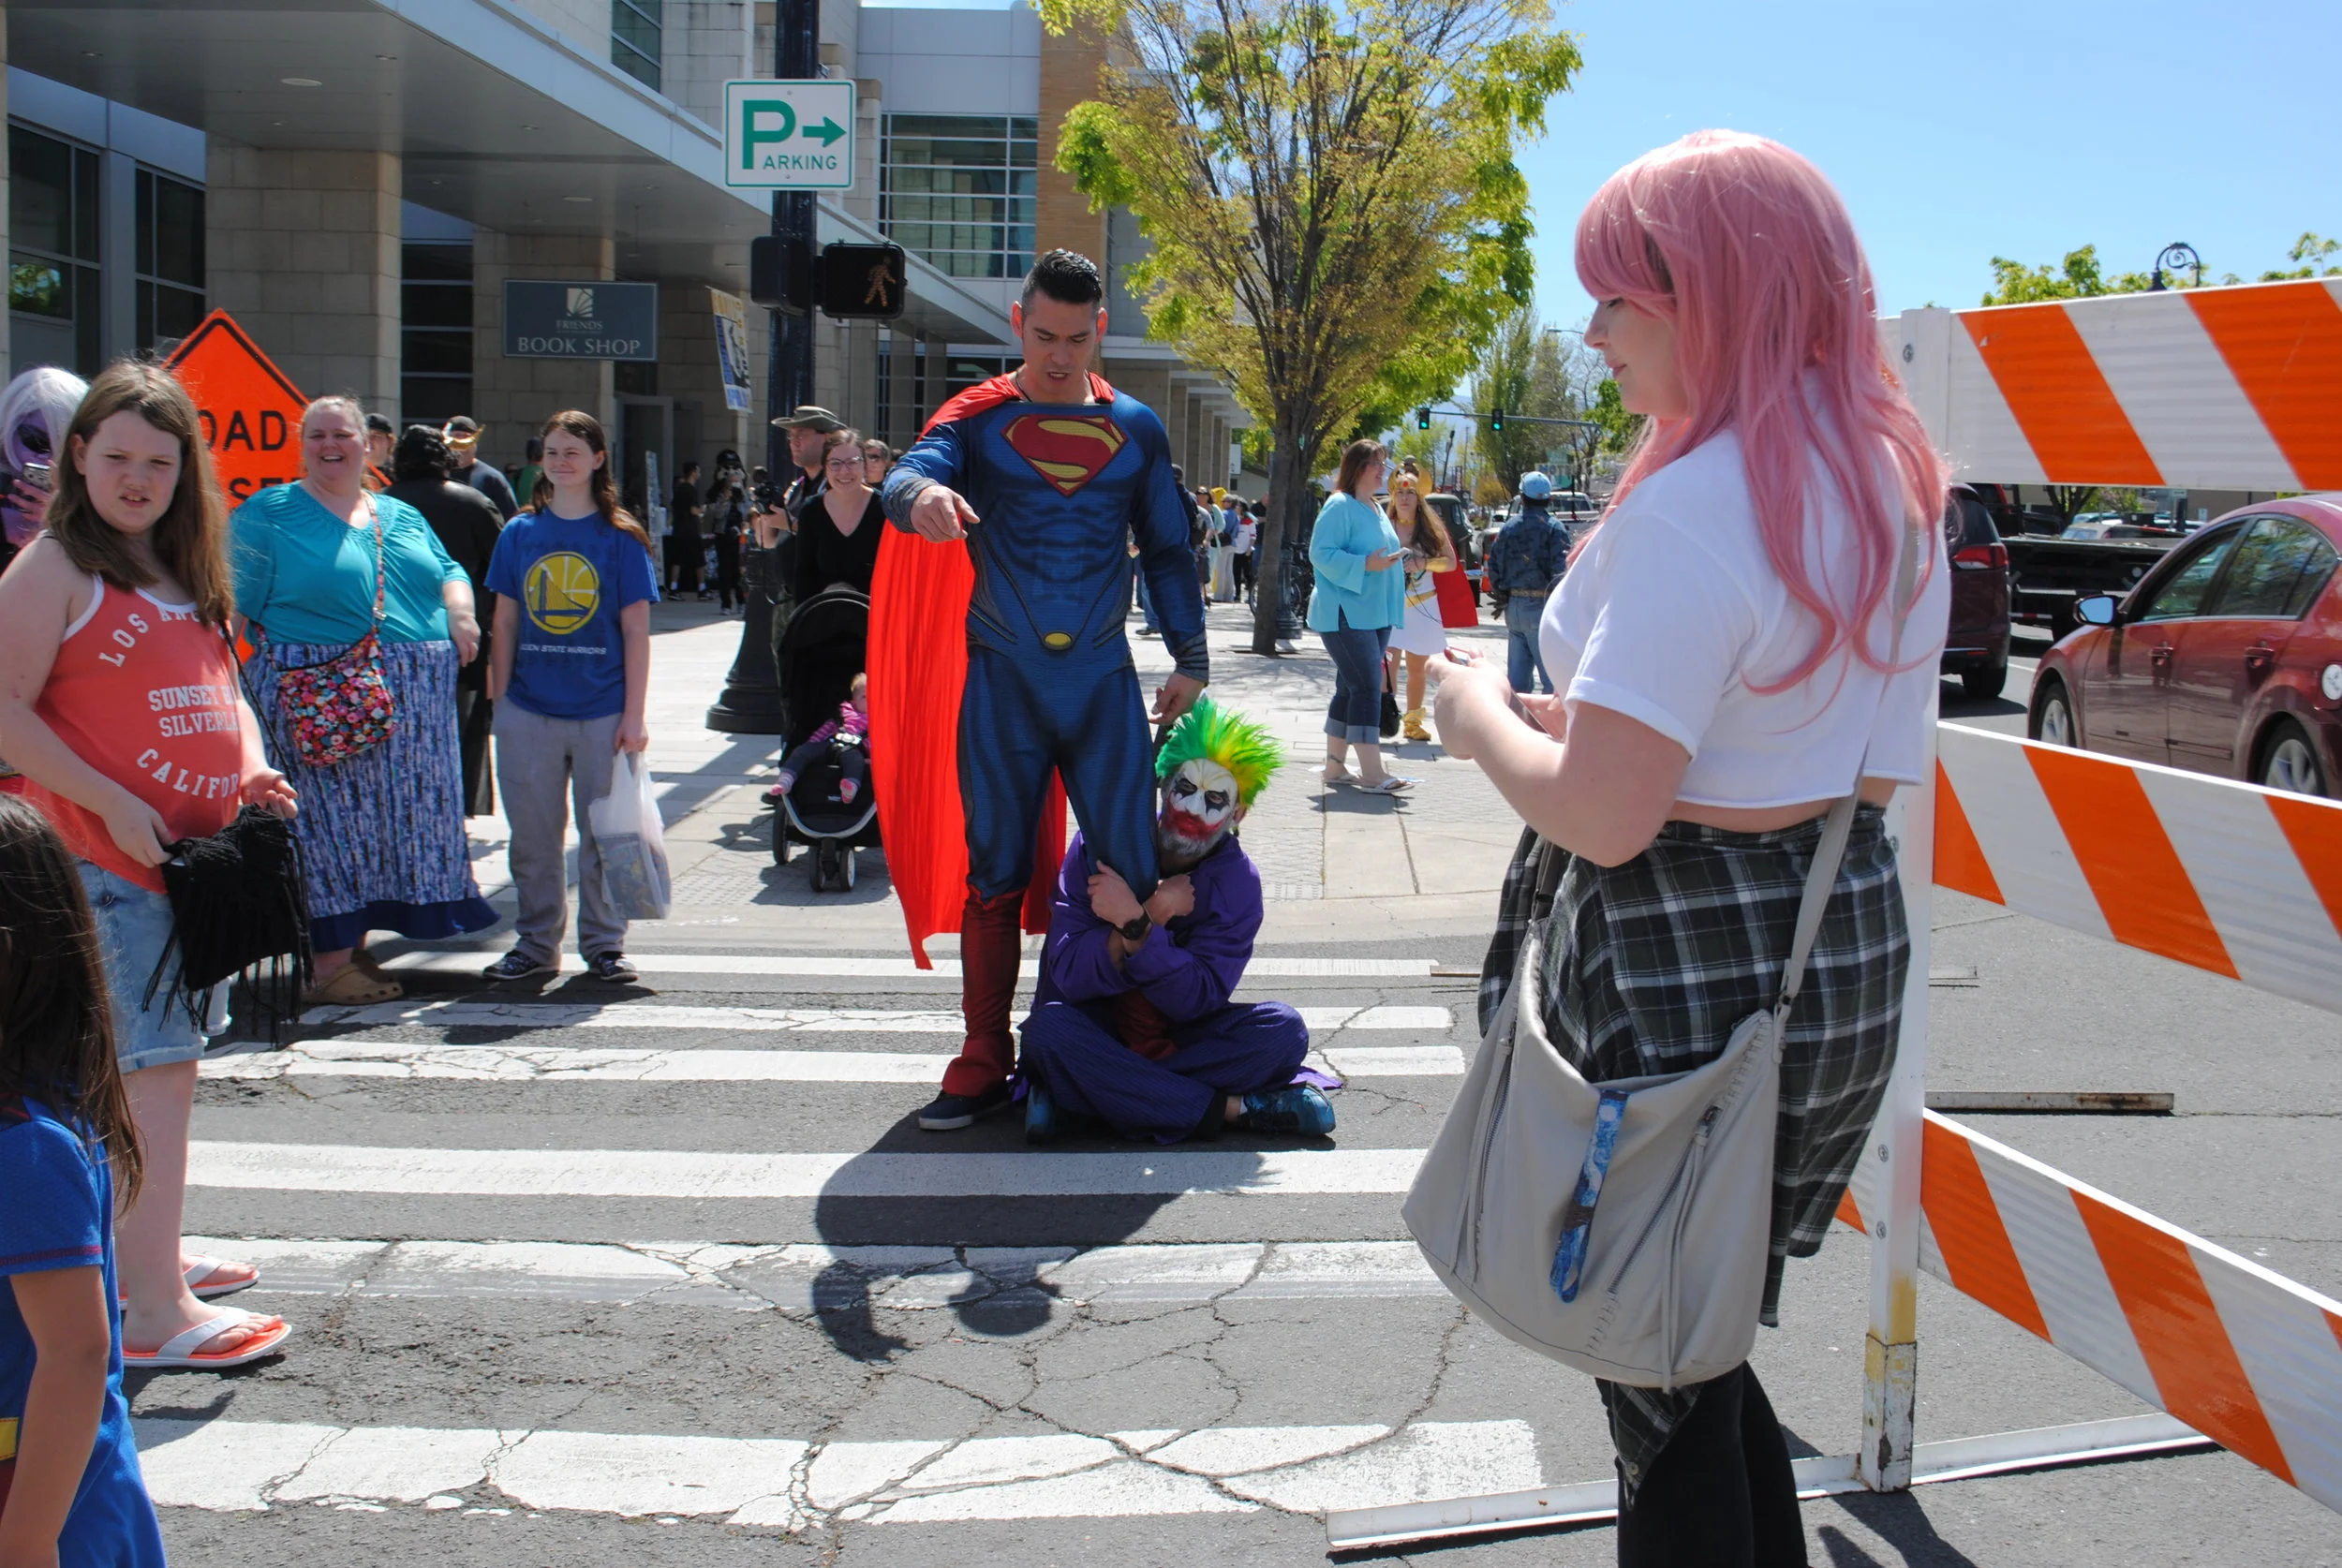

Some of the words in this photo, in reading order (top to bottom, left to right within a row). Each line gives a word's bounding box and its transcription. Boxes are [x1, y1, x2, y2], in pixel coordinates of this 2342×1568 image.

[556, 319, 603, 331] FRIENDS
[517, 336, 577, 353] BOOK
[584, 338, 641, 355] SHOP
[197, 409, 288, 451] OAD
[98, 613, 149, 667] LOS
[541, 644, 567, 654] STATE
[148, 685, 219, 712] SUNSET
[158, 711, 240, 738] SILVERLA
[137, 748, 239, 799] CALIFOR
